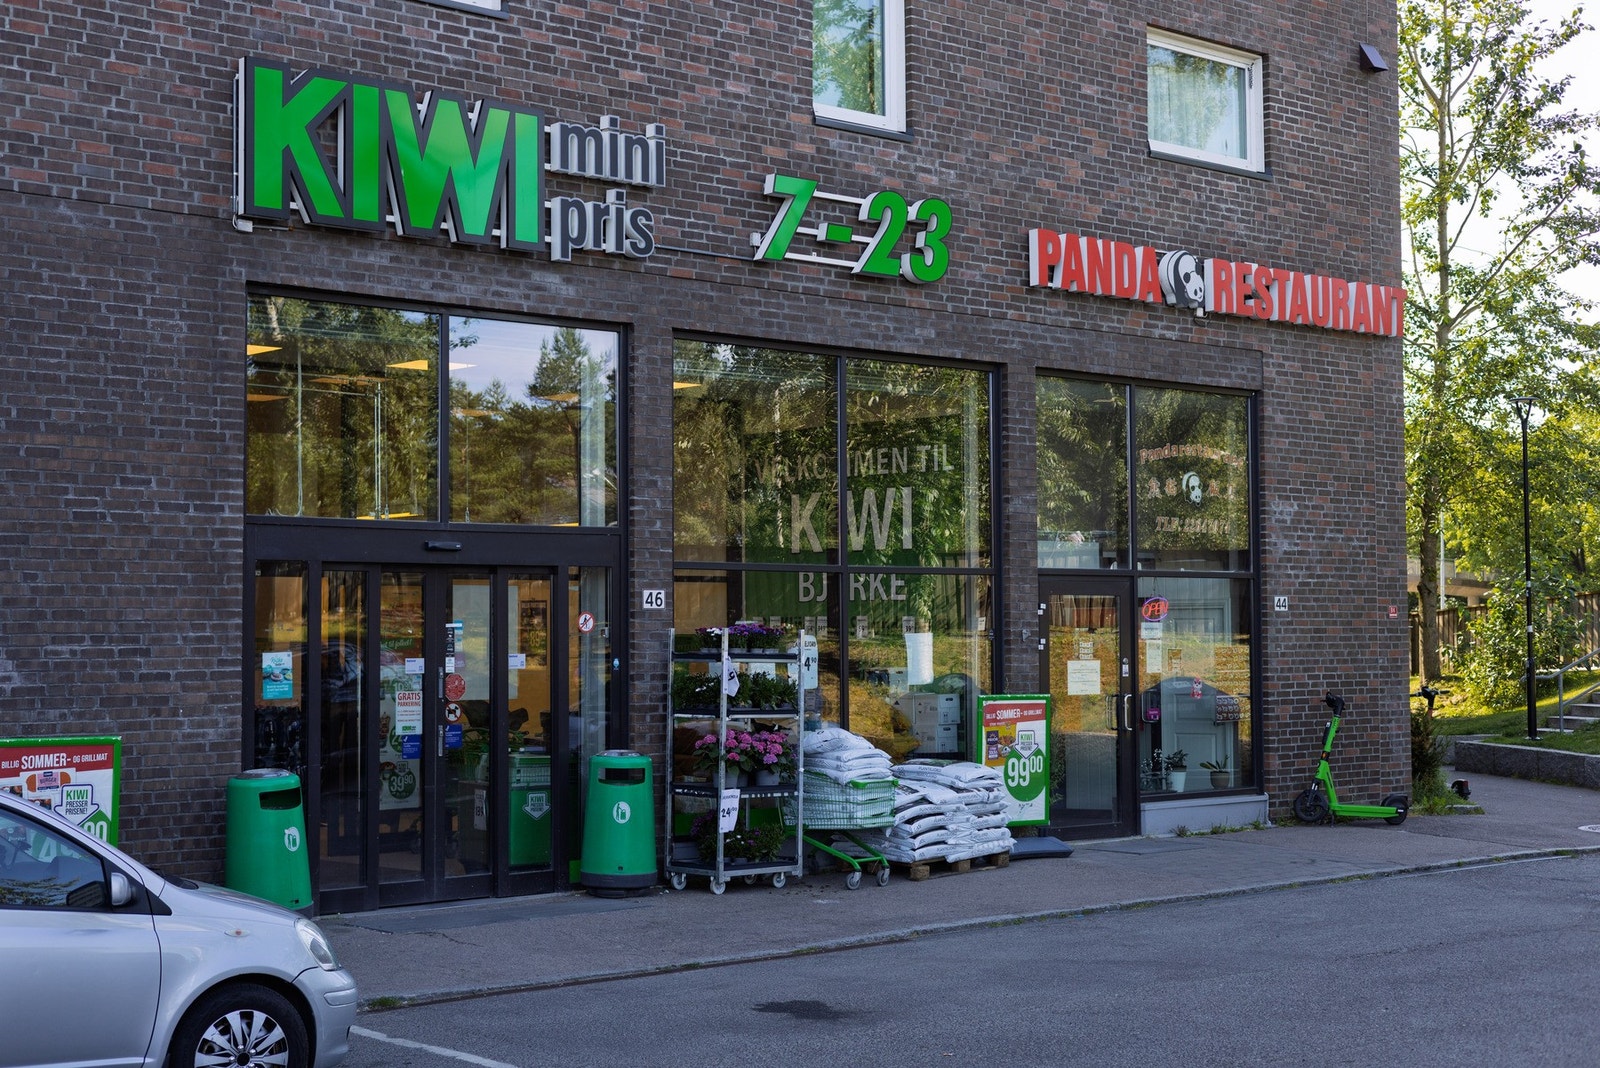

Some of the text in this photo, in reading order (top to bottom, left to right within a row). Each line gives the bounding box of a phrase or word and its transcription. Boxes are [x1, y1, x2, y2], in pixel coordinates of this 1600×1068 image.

[241, 57, 545, 251] KIWI
[550, 115, 666, 188] mini
[550, 189, 656, 262] pris
[754, 173, 953, 284] 7-23
[1029, 227, 1408, 338] PANDA RESTAURANT
[917, 443, 954, 473] TIL
[791, 486, 913, 554] KWI
[644, 591, 664, 608] 46
[798, 573, 908, 603] BJRKE
[1142, 600, 1169, 618] OPEN
[1275, 598, 1287, 610] 44
[397, 692, 421, 701] GRATIS
[1, 752, 108, 769] BILLIG SOMMER- OG GRILLMAT
[65, 800, 88, 808] PRESSER
[66, 789, 89, 800] KIWI
[65, 807, 88, 816] PRISENE!
